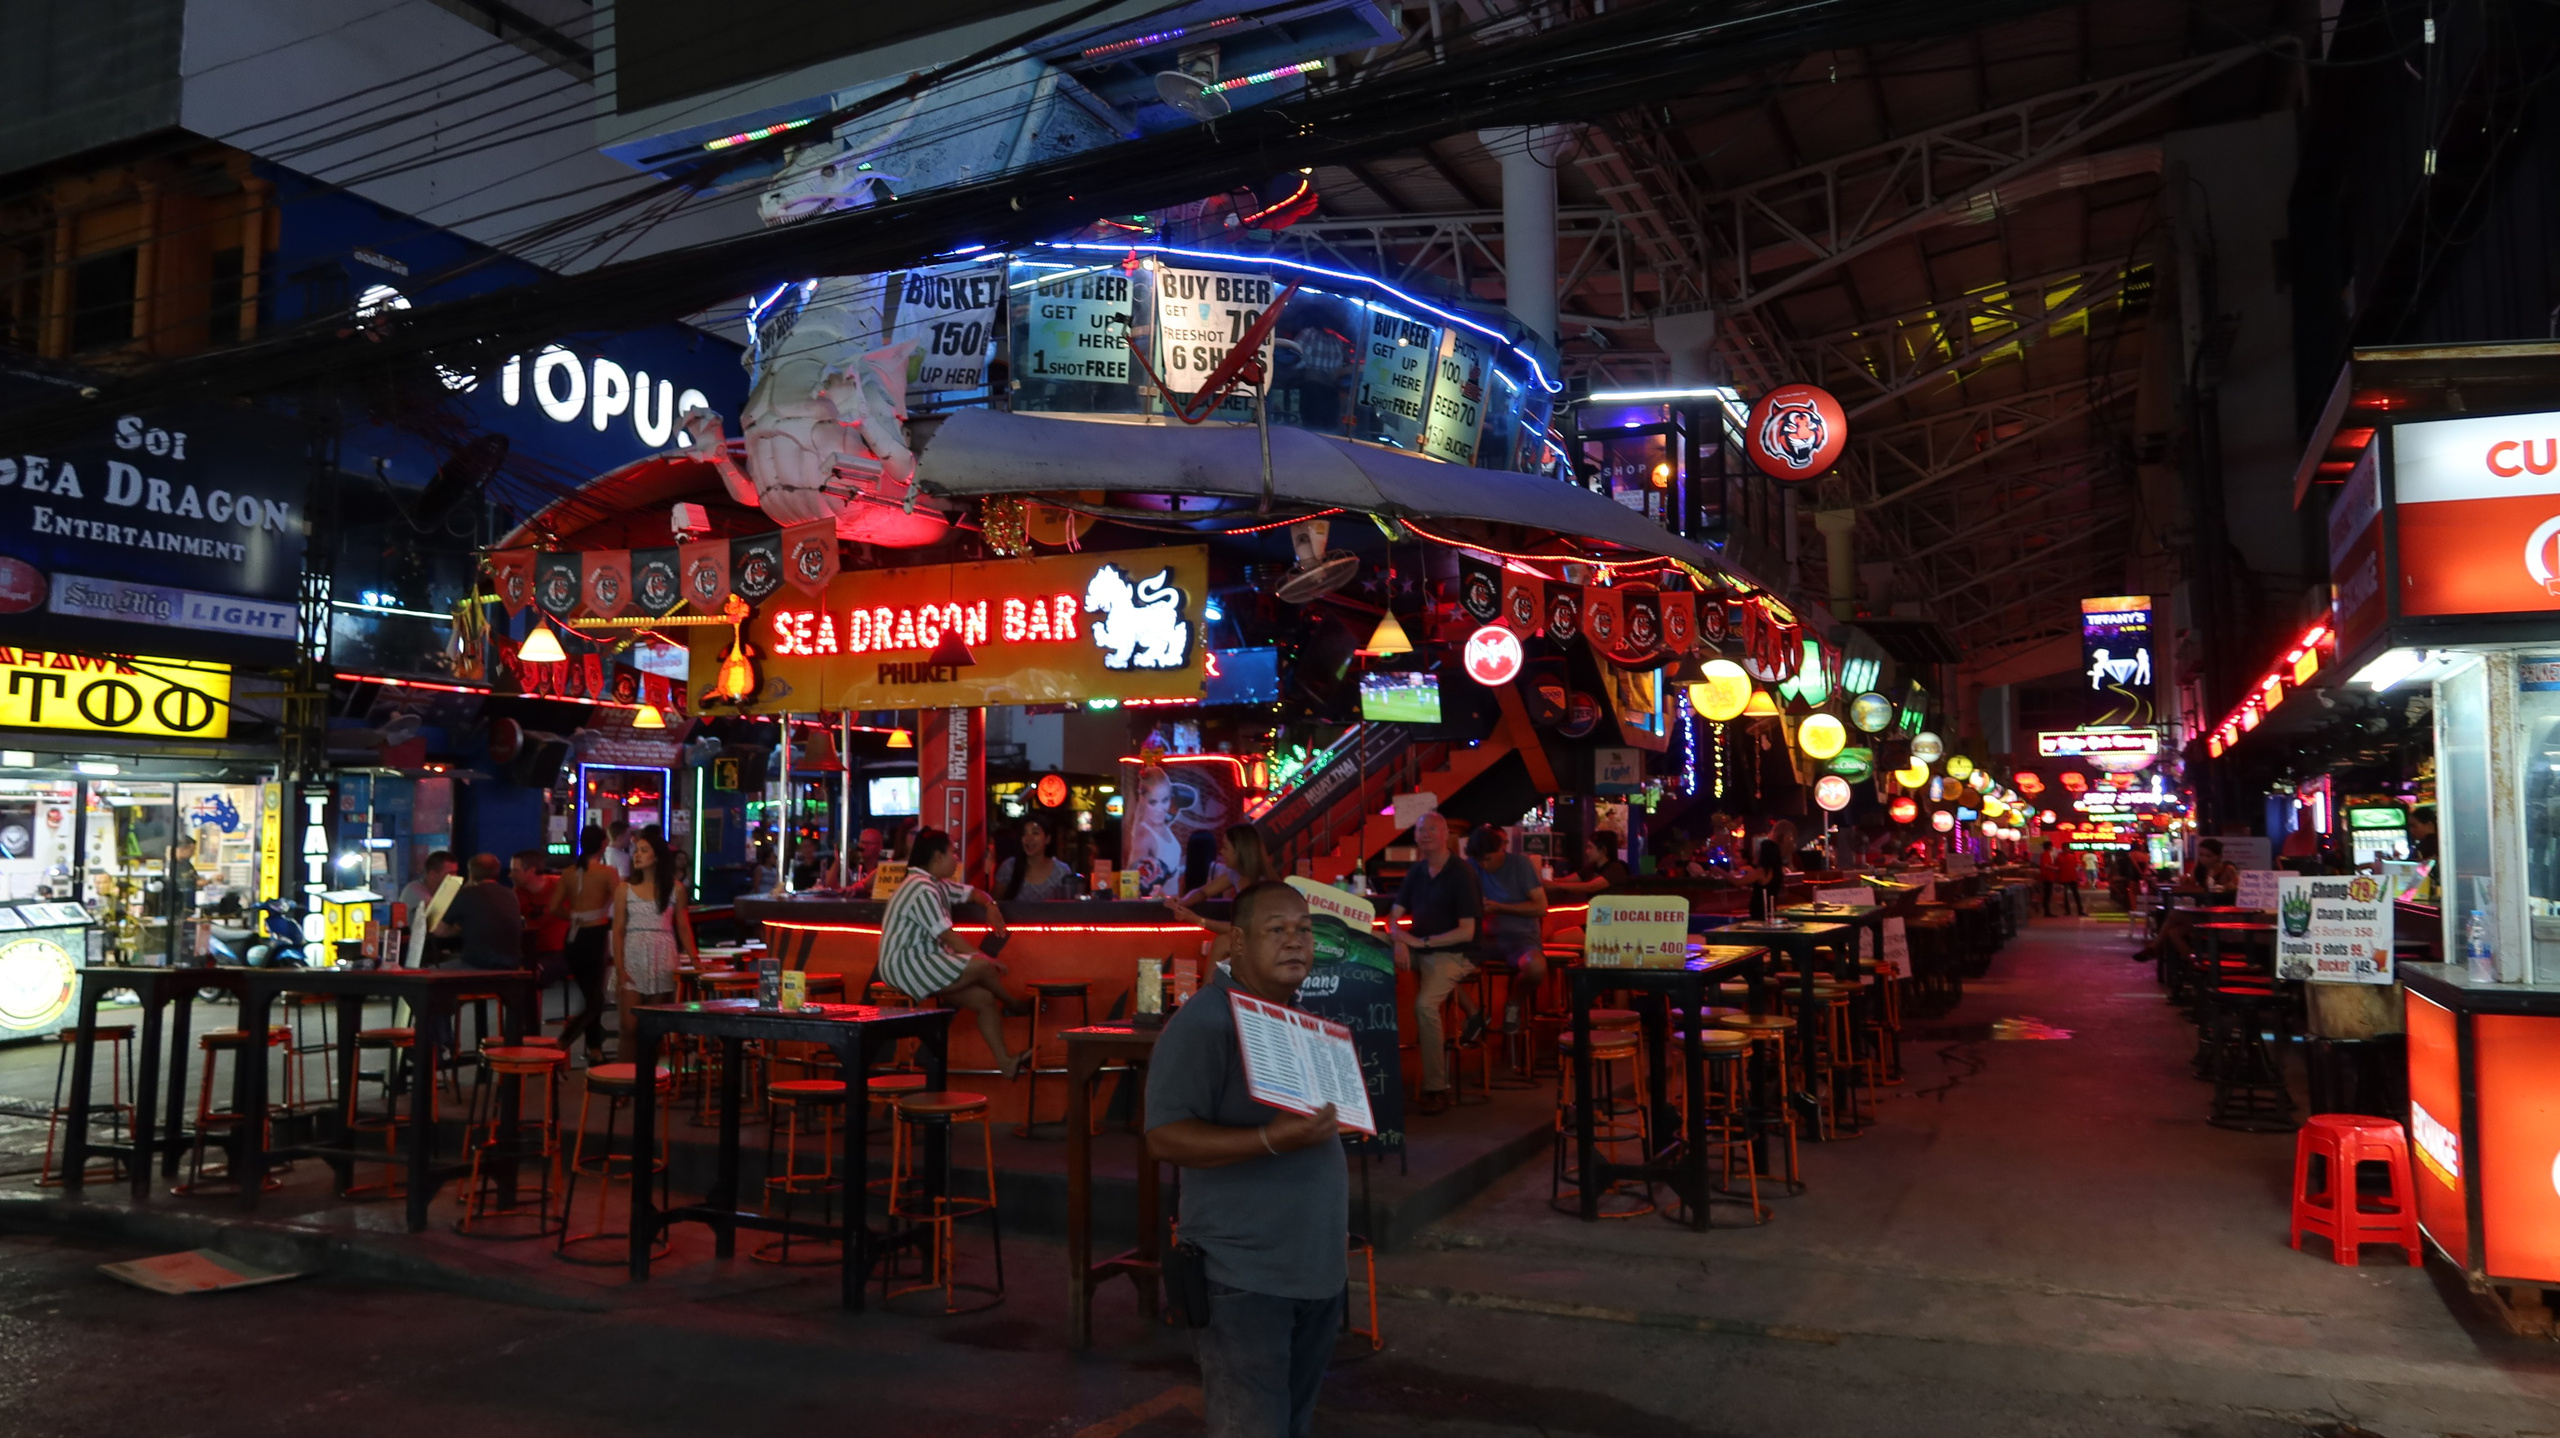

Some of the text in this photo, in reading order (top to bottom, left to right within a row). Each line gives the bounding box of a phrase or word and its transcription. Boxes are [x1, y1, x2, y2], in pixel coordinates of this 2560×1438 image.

[905, 273, 1000, 310] BUCKET
[1081, 276, 1128, 302] BEER
[1162, 274, 1271, 305] BUY BEER
[1041, 304, 1077, 320] GET
[1164, 305, 1188, 317] GET
[1373, 313, 1400, 341] BUY
[1079, 333, 1127, 350] HERE
[1372, 342, 1396, 360] GET
[1032, 349, 1127, 379] 1 SHOT FREE
[1172, 345, 1268, 375] 6 SHS
[1401, 356, 1418, 372] UP
[1441, 359, 1461, 385] 100
[920, 366, 942, 384] UP
[1392, 373, 1422, 393] HERE
[1360, 383, 1371, 406] 1
[1392, 398, 1419, 418] FREE
[1434, 394, 1476, 427] BEER 70
[1603, 463, 1647, 477] SHOP
[32, 505, 246, 562] ENTERTAINMENT
[191, 601, 287, 630] LIGHT
[772, 592, 1079, 655] SEA DRAGON BAR
[2085, 611, 2147, 626] TIFFANY'S
[877, 661, 960, 686] PHUKET
[1303, 776, 1335, 807] MUAY
[1330, 757, 1358, 781] THAI
[2311, 882, 2348, 900] Chang
[1306, 893, 1372, 924] LOCAL BEER
[1613, 910, 1685, 923] LOCAL BEER
[2316, 907, 2378, 922] Chang Bucket
[1659, 941, 1684, 954] 400
[2322, 943, 2349, 956] shots
